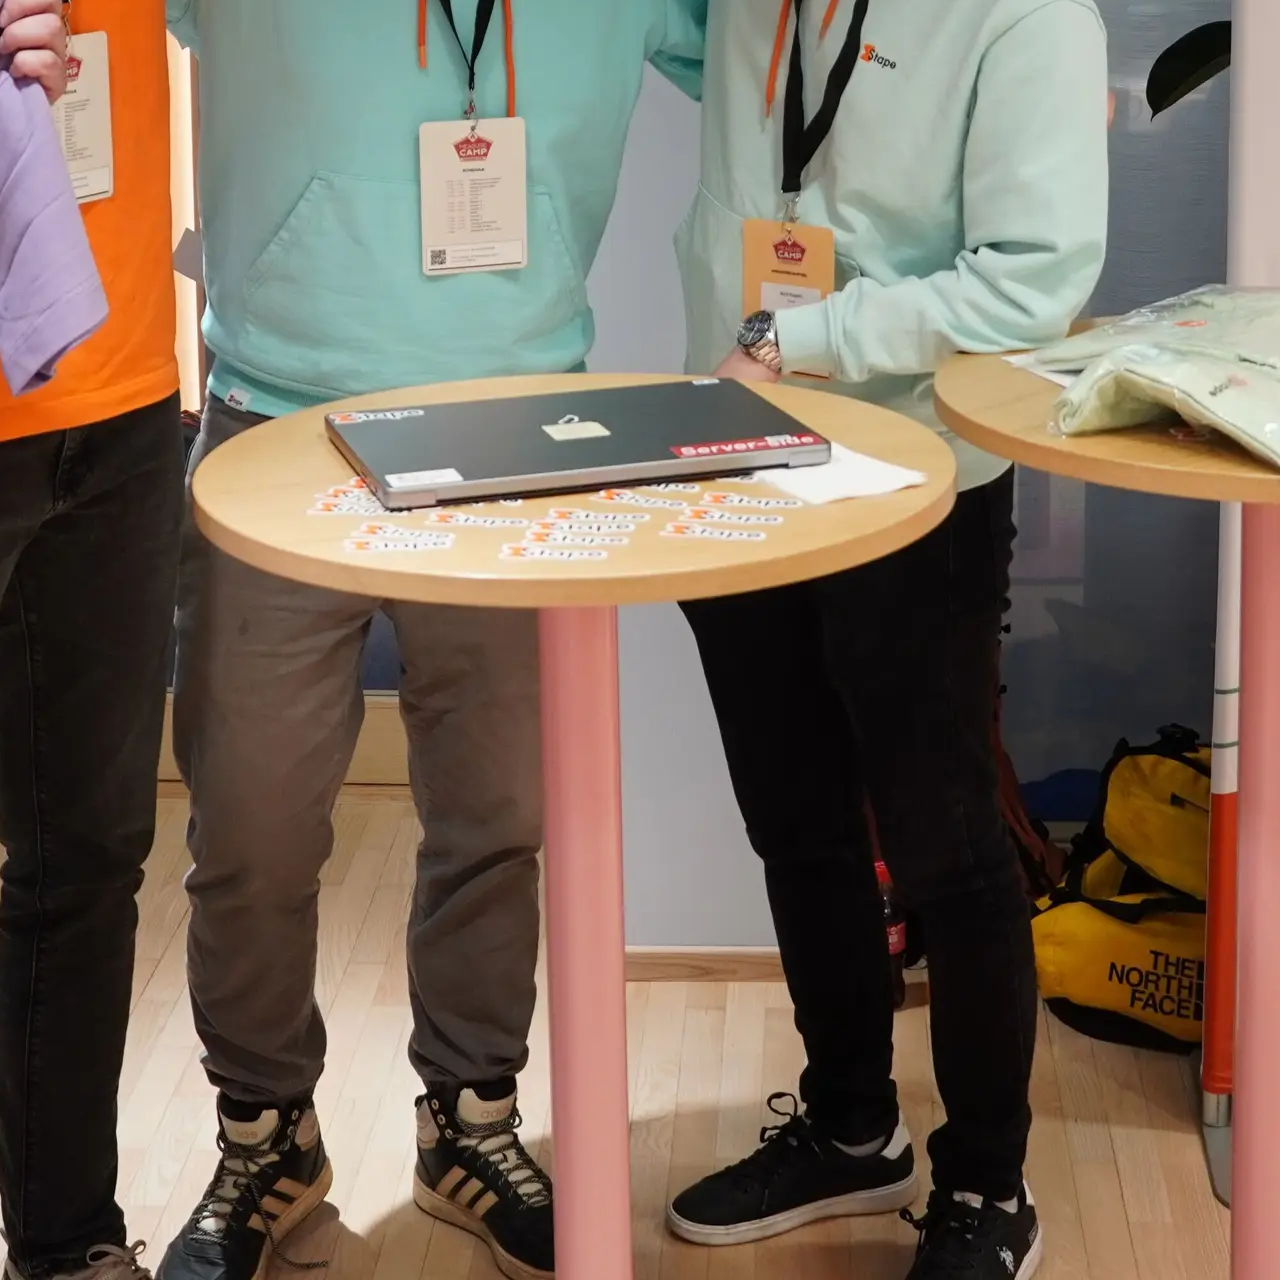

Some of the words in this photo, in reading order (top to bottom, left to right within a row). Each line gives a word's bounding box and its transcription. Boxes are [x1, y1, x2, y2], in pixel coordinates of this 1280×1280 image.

[867, 46, 897, 70] Stape
[459, 147, 488, 157] CAMP
[1149, 949, 1196, 979] THE
[1108, 961, 1194, 999] NORTH
[1130, 988, 1192, 1019] FACE
